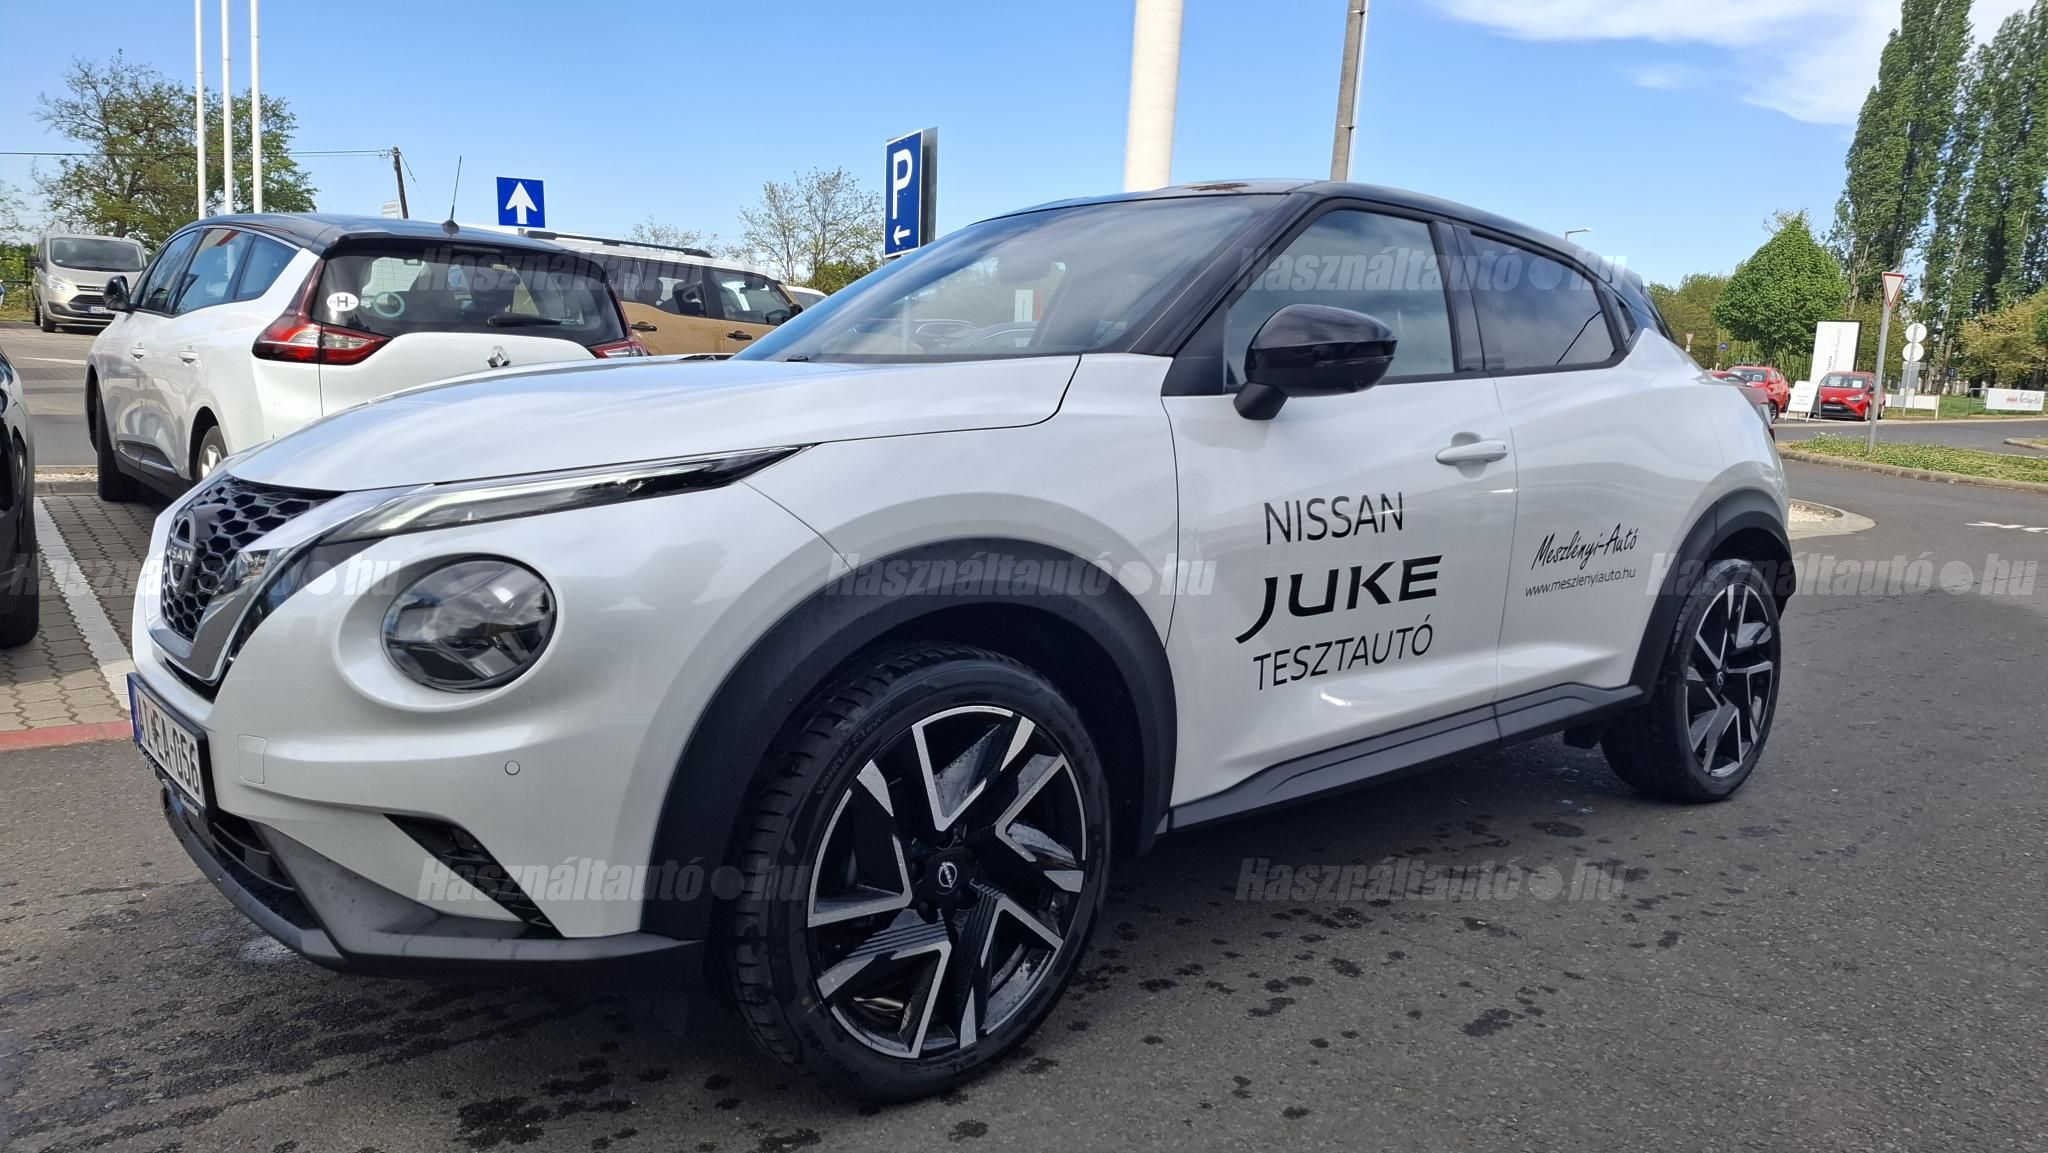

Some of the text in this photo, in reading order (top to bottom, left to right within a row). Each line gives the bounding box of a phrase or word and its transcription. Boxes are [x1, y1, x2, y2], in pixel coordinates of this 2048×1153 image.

[892, 148, 913, 220] P
[336, 295, 349, 308] H
[1263, 491, 1403, 545] NISSAN
[1530, 522, 1639, 571] Meszlényi-Autó
[1234, 554, 1443, 645] JUKE
[1525, 567, 1636, 597] www.meszlenyiauto.hu
[1252, 614, 1434, 690] TESZTAUTÓ
